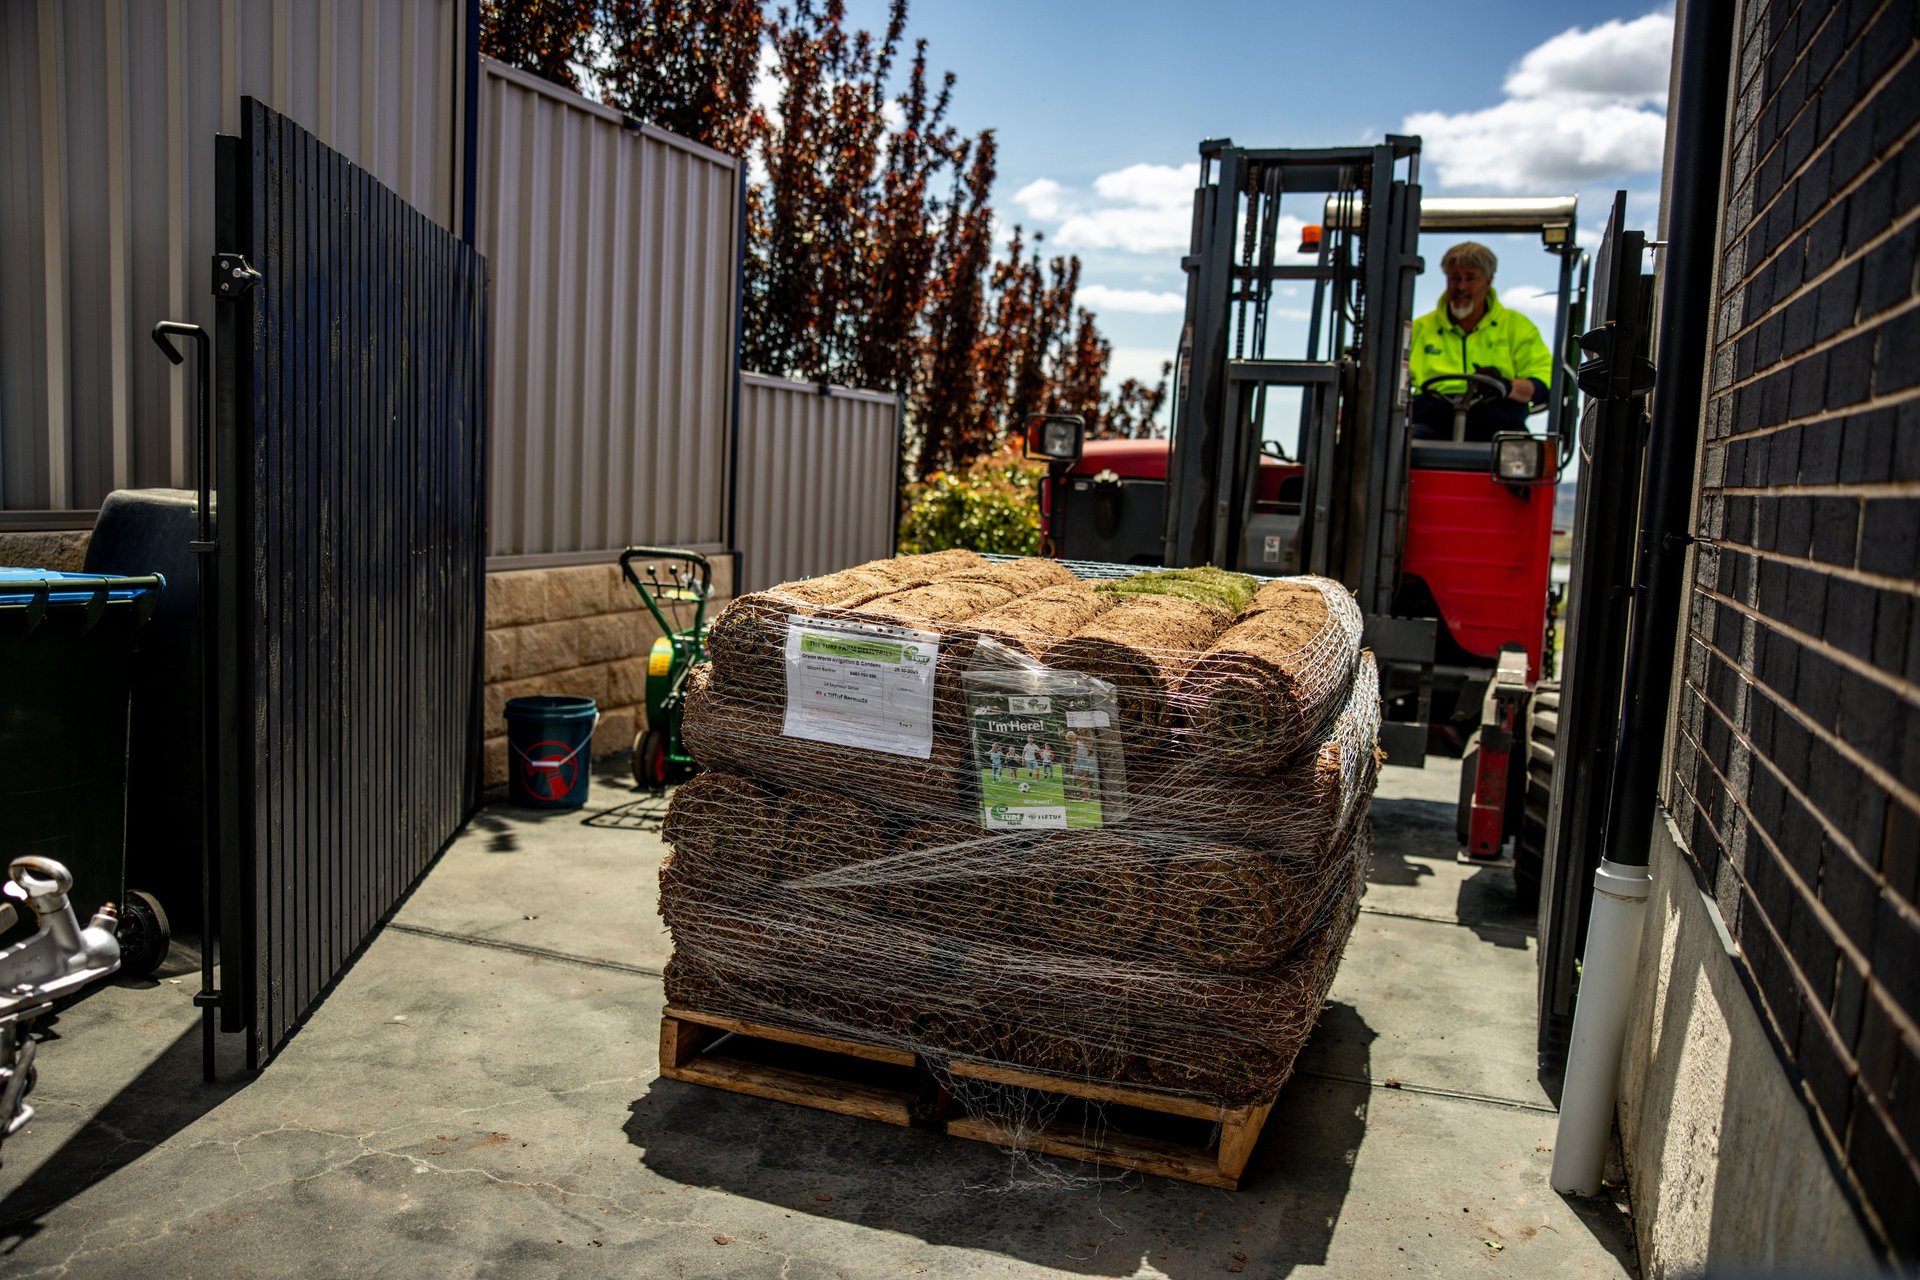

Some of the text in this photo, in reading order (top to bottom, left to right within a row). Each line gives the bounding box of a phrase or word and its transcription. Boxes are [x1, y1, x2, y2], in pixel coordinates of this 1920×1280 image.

[809, 640, 821, 648] THE
[801, 652, 817, 660] Green
[988, 719, 1044, 732] I'm Here!
